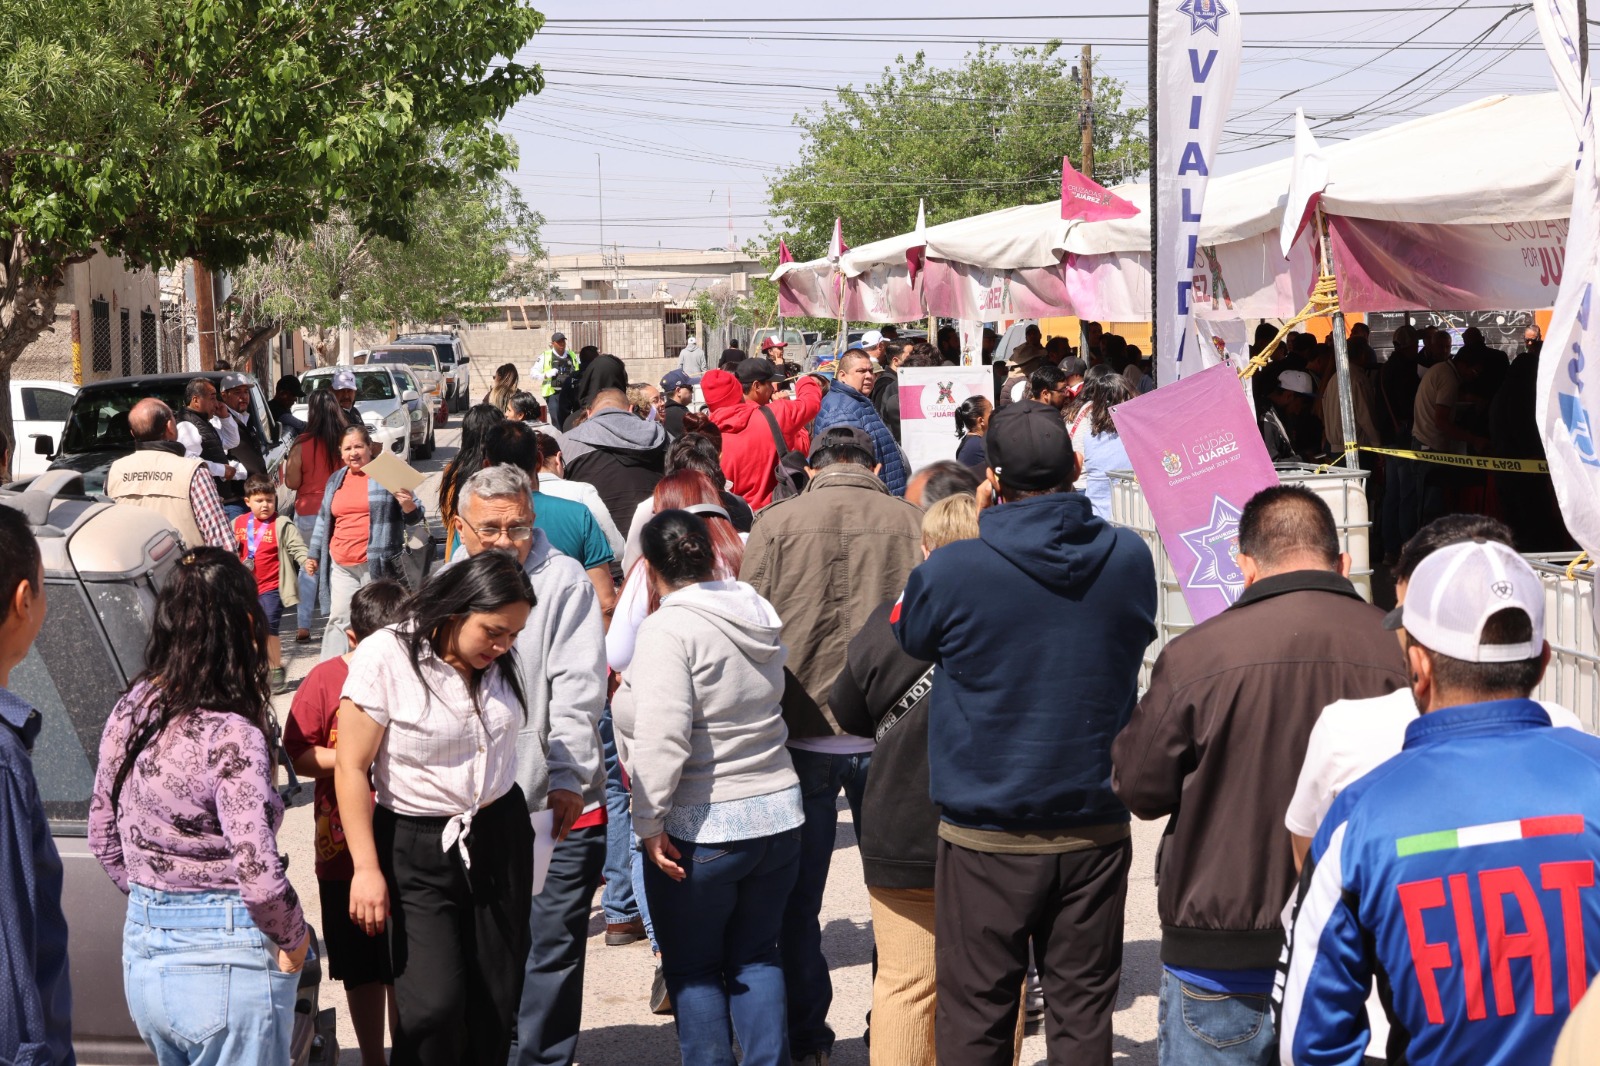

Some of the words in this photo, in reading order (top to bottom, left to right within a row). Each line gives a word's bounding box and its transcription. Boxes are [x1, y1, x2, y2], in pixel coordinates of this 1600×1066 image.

[1068, 184, 1102, 199] CRUZADAS
[1521, 247, 1539, 267] POR
[932, 410, 955, 418] JUÁRE
[1192, 432, 1234, 455] CIUDAD
[1197, 441, 1239, 465] JUÁREZ
[122, 471, 173, 482] SUPERVISOR
[1168, 475, 1191, 487] Gobierno
[1191, 464, 1215, 478] Municipal
[898, 677, 933, 709] LOLA
[1397, 860, 1595, 1025] FIAT
